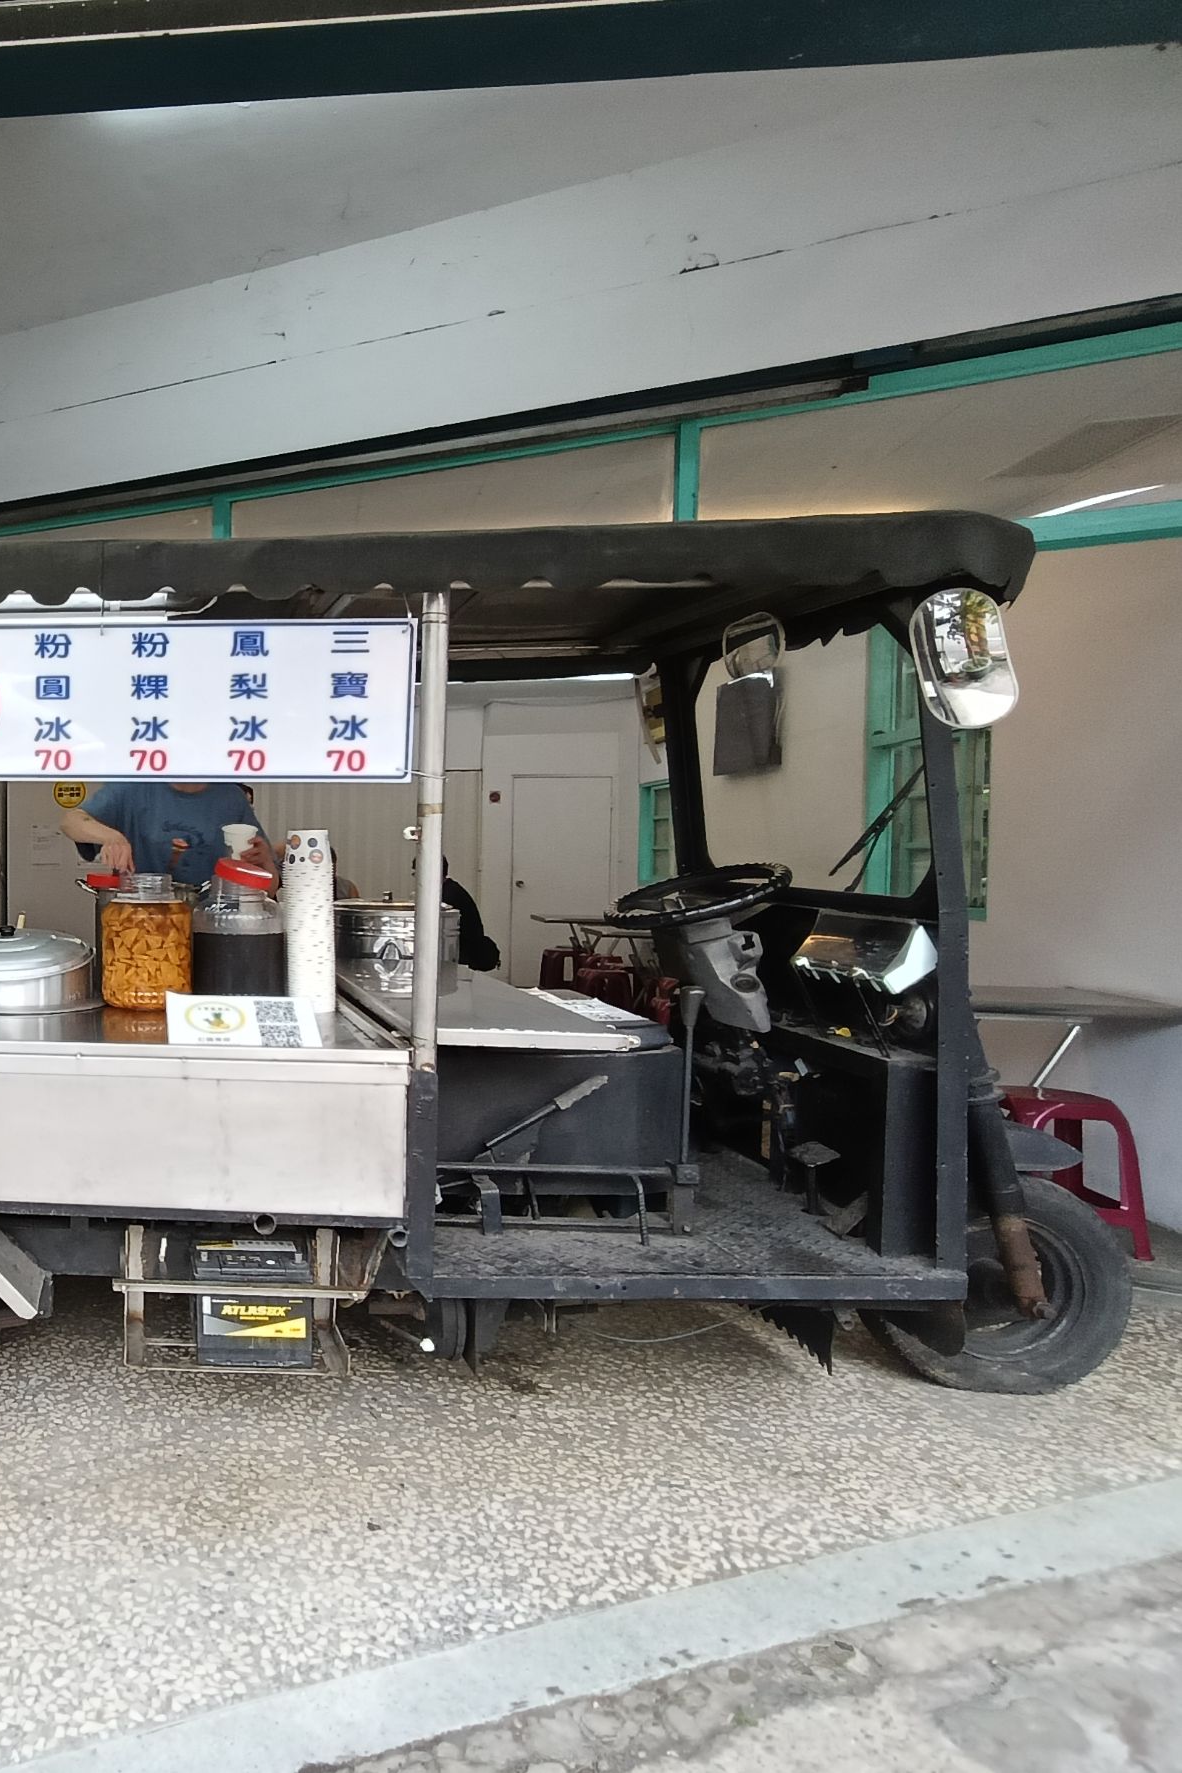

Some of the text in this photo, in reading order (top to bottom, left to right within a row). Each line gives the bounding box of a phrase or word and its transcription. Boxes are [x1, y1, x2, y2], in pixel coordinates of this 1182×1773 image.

[34, 632, 72, 743] 粉圓冰
[129, 632, 170, 772] 粉粿冰 70
[227, 630, 270, 772] 鳳梨冰 70
[326, 630, 370, 772] 三寶冰 70
[34, 749, 72, 771] 70
